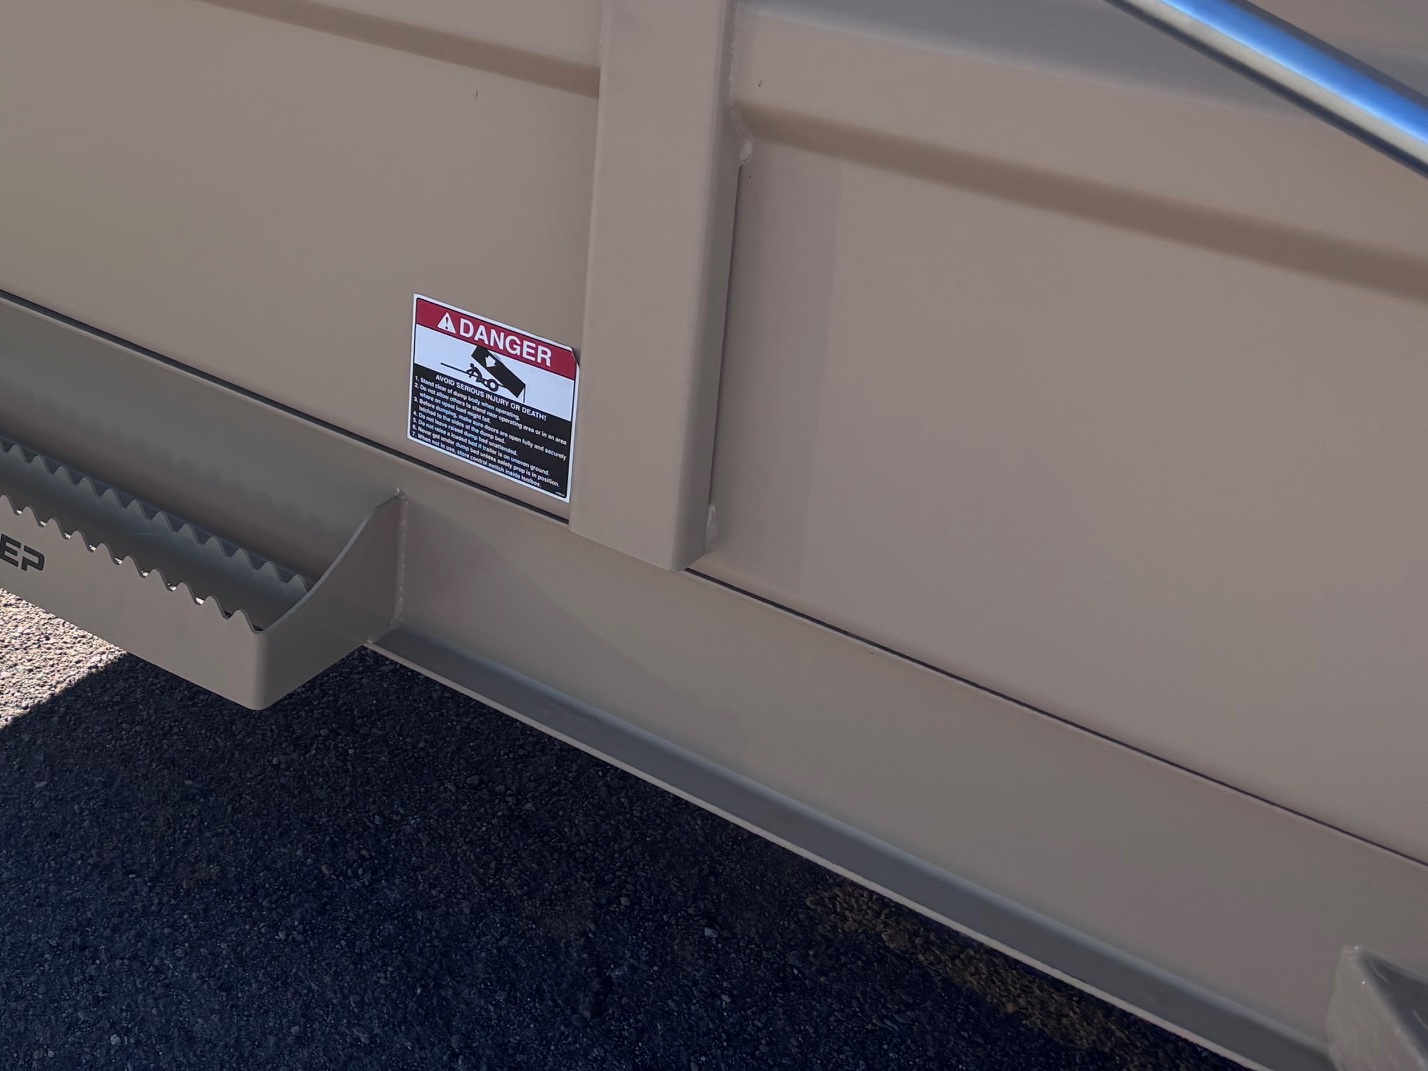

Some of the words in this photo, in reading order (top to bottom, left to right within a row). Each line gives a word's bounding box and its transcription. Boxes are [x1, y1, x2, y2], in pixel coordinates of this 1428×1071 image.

[459, 317, 552, 368] DANGER
[420, 377, 434, 387] Stand
[435, 383, 446, 391] clear
[453, 389, 467, 400] dump
[468, 395, 480, 405] body
[481, 400, 494, 409] when
[495, 405, 520, 420] operating.
[435, 374, 454, 386] AVOID
[456, 381, 484, 397] SERIOUS
[485, 392, 509, 407] INJURY
[510, 402, 520, 411] OR
[521, 406, 546, 421] DEATH!
[436, 391, 448, 400] allow
[449, 396, 465, 406] others
[472, 404, 485, 414] stand
[498, 414, 522, 429] operating
[419, 398, 434, 408] Before
[458, 413, 471, 422] make
[484, 423, 498, 433] doors
[508, 434, 521, 443] open
[522, 438, 533, 448] fully
[534, 442, 544, 450] and
[544, 446, 566, 460] securely
